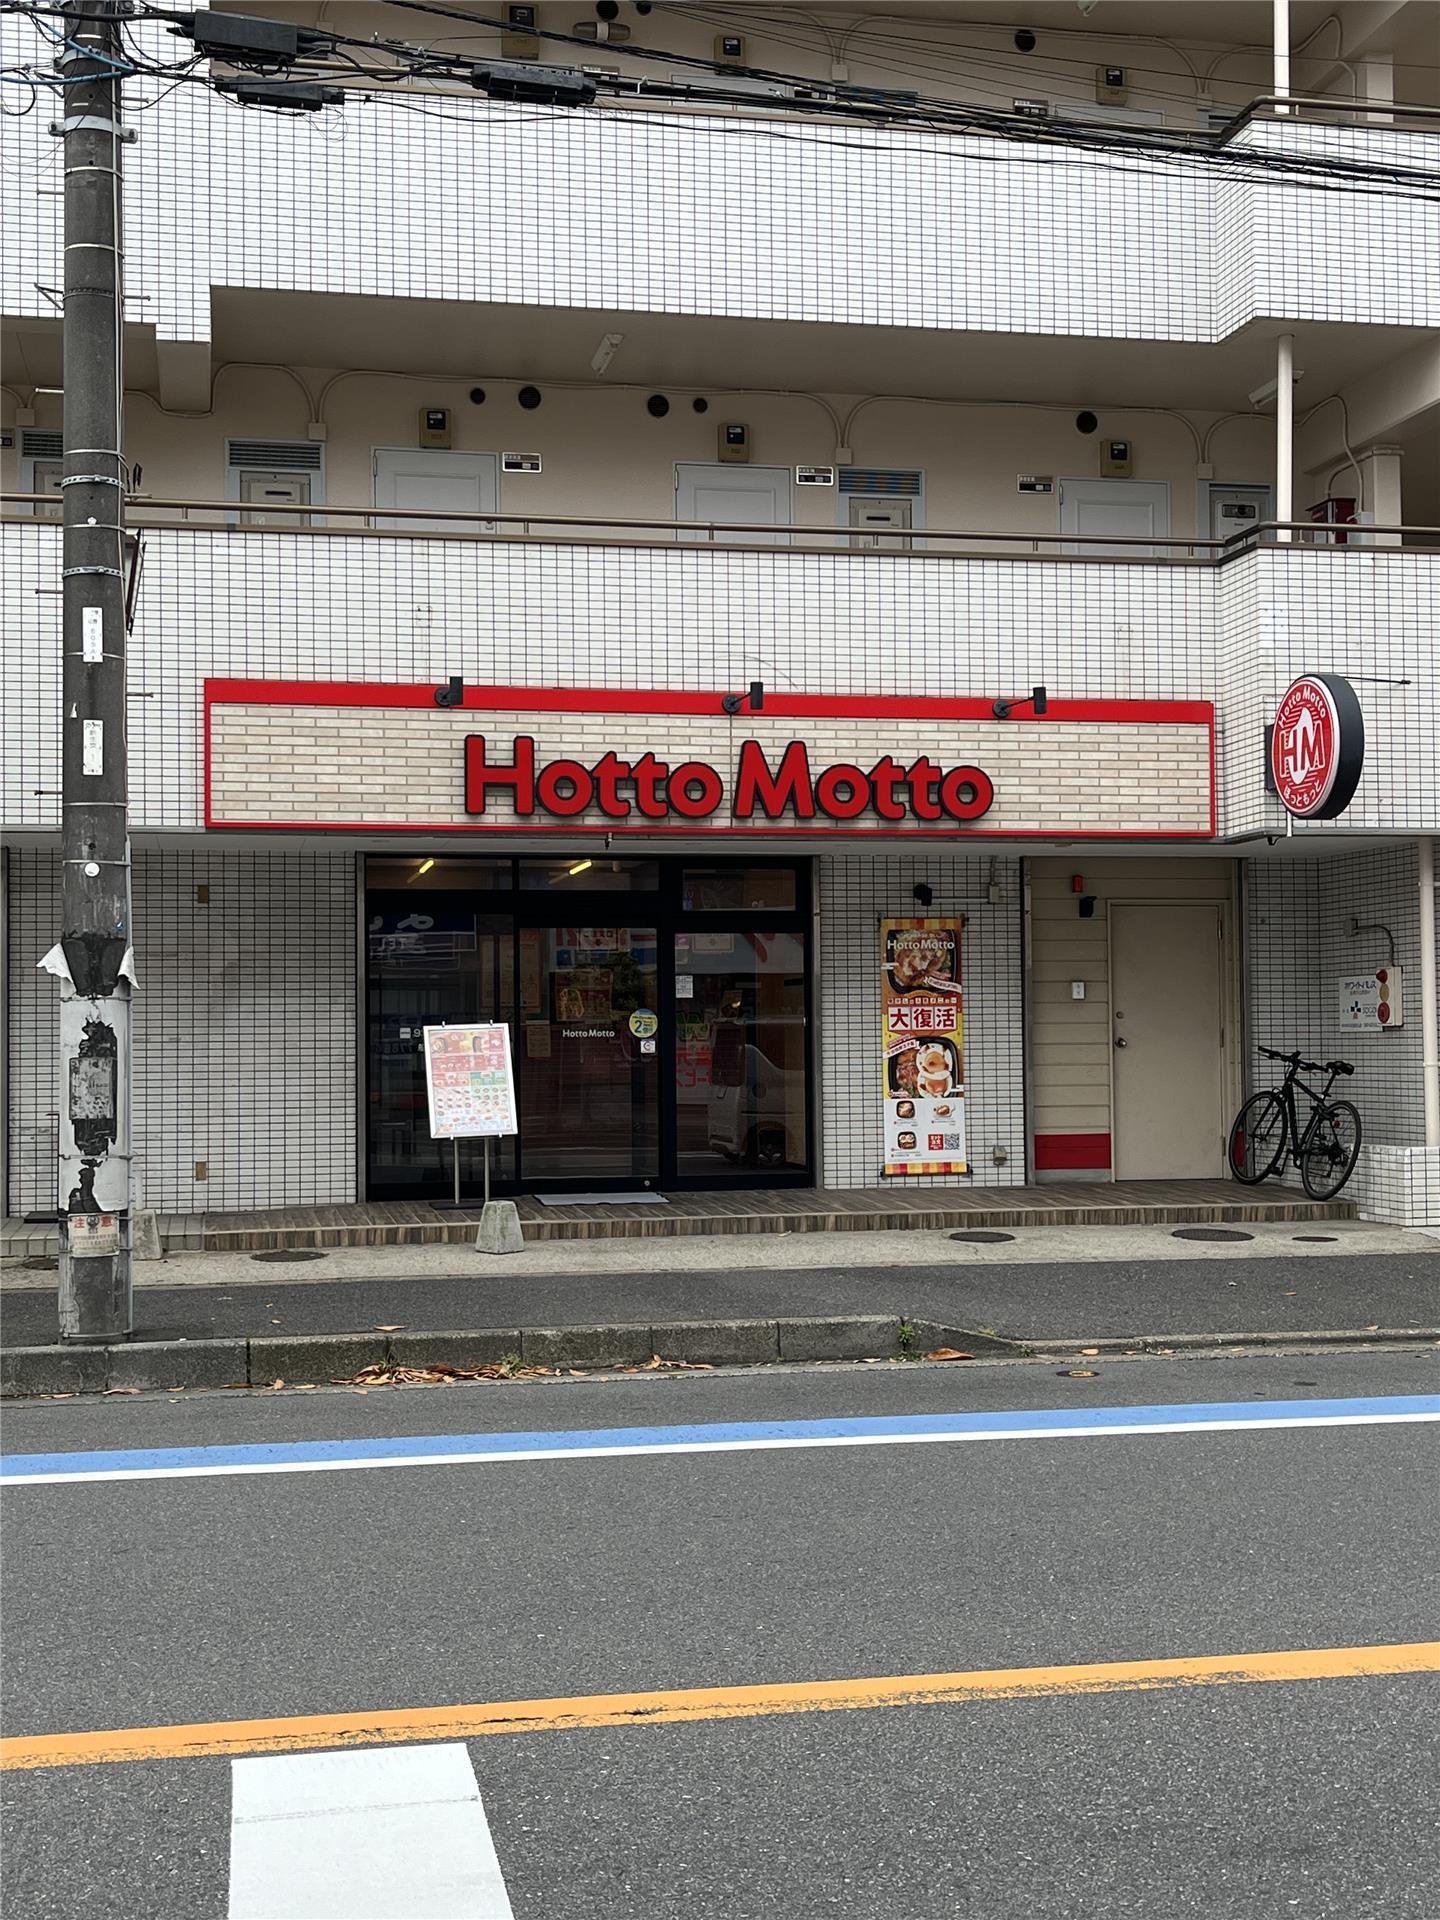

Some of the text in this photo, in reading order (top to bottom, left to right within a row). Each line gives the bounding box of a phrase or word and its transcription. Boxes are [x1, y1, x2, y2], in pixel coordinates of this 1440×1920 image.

[1279, 720, 1326, 779] HM
[890, 1008, 955, 1027] 大復活
